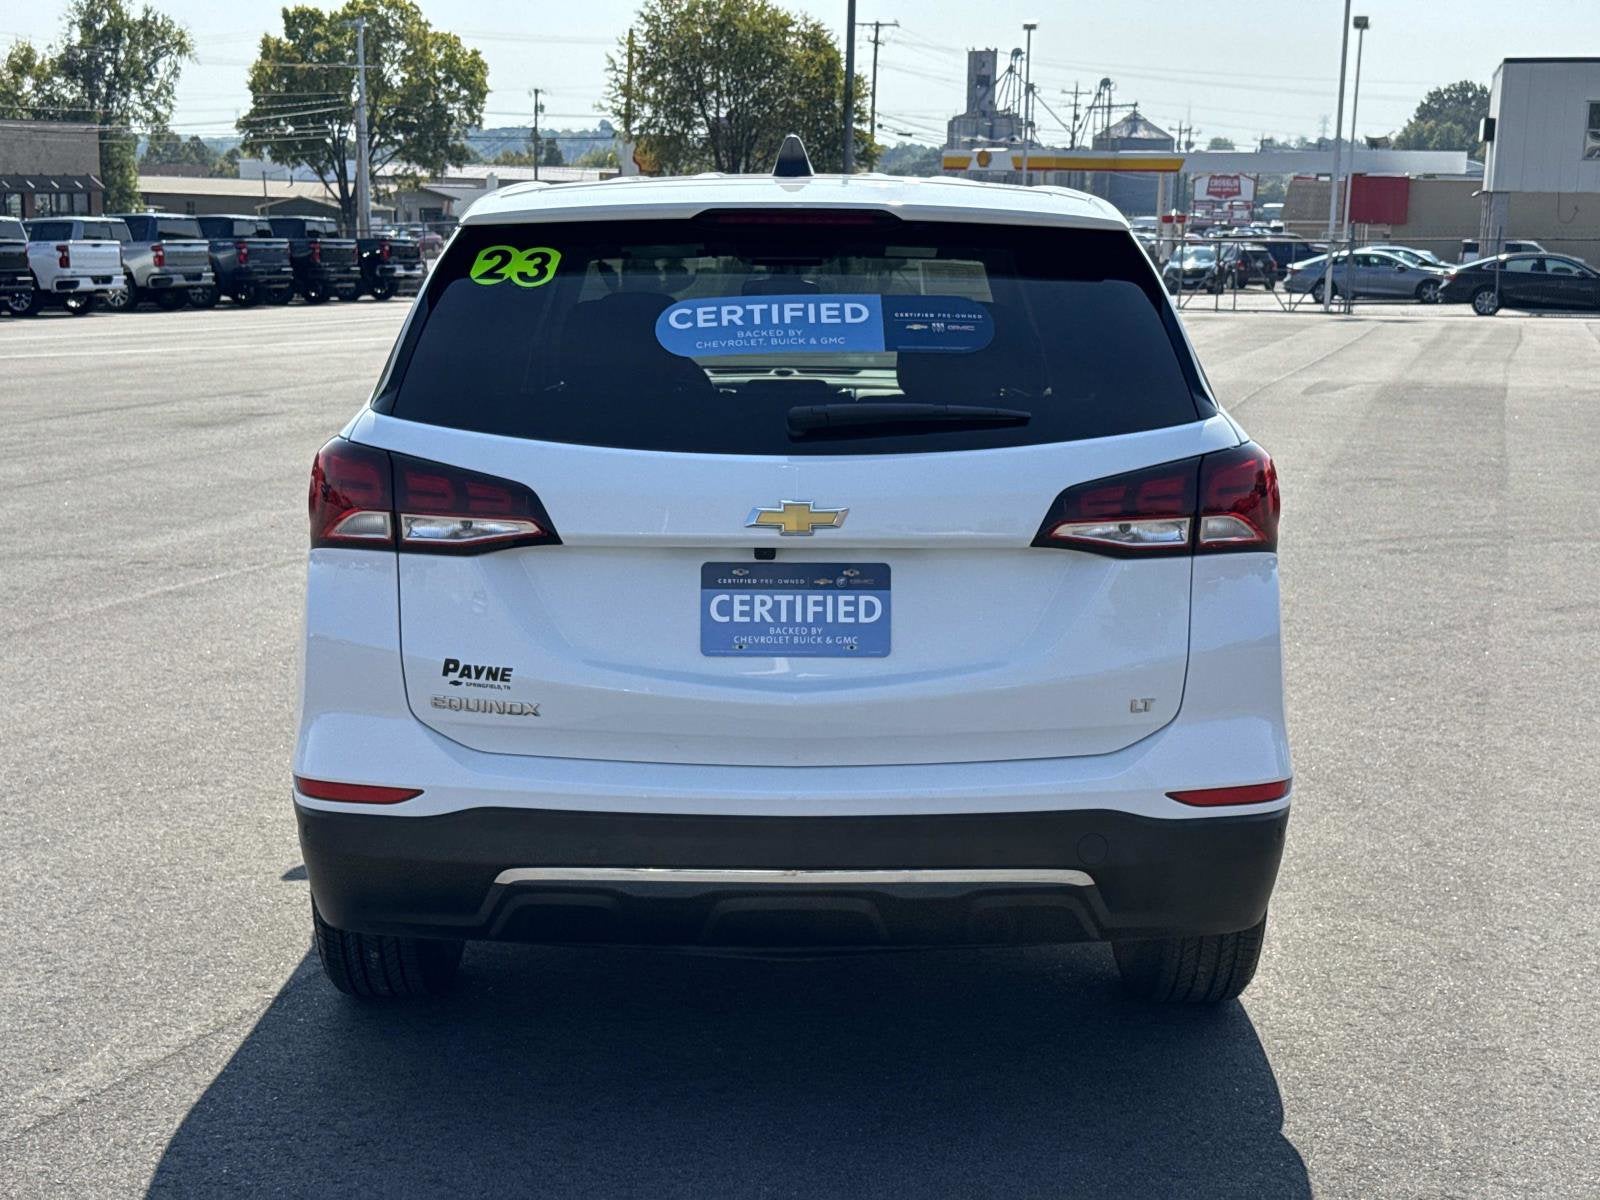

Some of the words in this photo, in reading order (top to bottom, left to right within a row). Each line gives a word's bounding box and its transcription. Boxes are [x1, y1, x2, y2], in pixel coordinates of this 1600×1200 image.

[473, 248, 553, 284] 23
[668, 303, 870, 330] CERTIFIED
[737, 329, 784, 338] BACKED
[788, 329, 804, 337] BY
[695, 338, 767, 349] CHEVROLET,
[770, 337, 805, 346] BUICK
[809, 337, 817, 345] &
[820, 336, 847, 345] GMC
[709, 594, 883, 624] CERTIFIED
[769, 627, 808, 635] BACKED
[811, 627, 823, 635] BY
[733, 635, 790, 645] CHEVROLET
[793, 636, 823, 645] BUICK
[825, 636, 833, 645] &
[835, 636, 858, 645] GMC
[442, 658, 513, 683] PAYNE
[465, 681, 503, 691] SPRINGFIELD,
[430, 694, 541, 717] EQUINOX
[1130, 698, 1156, 713] LT
